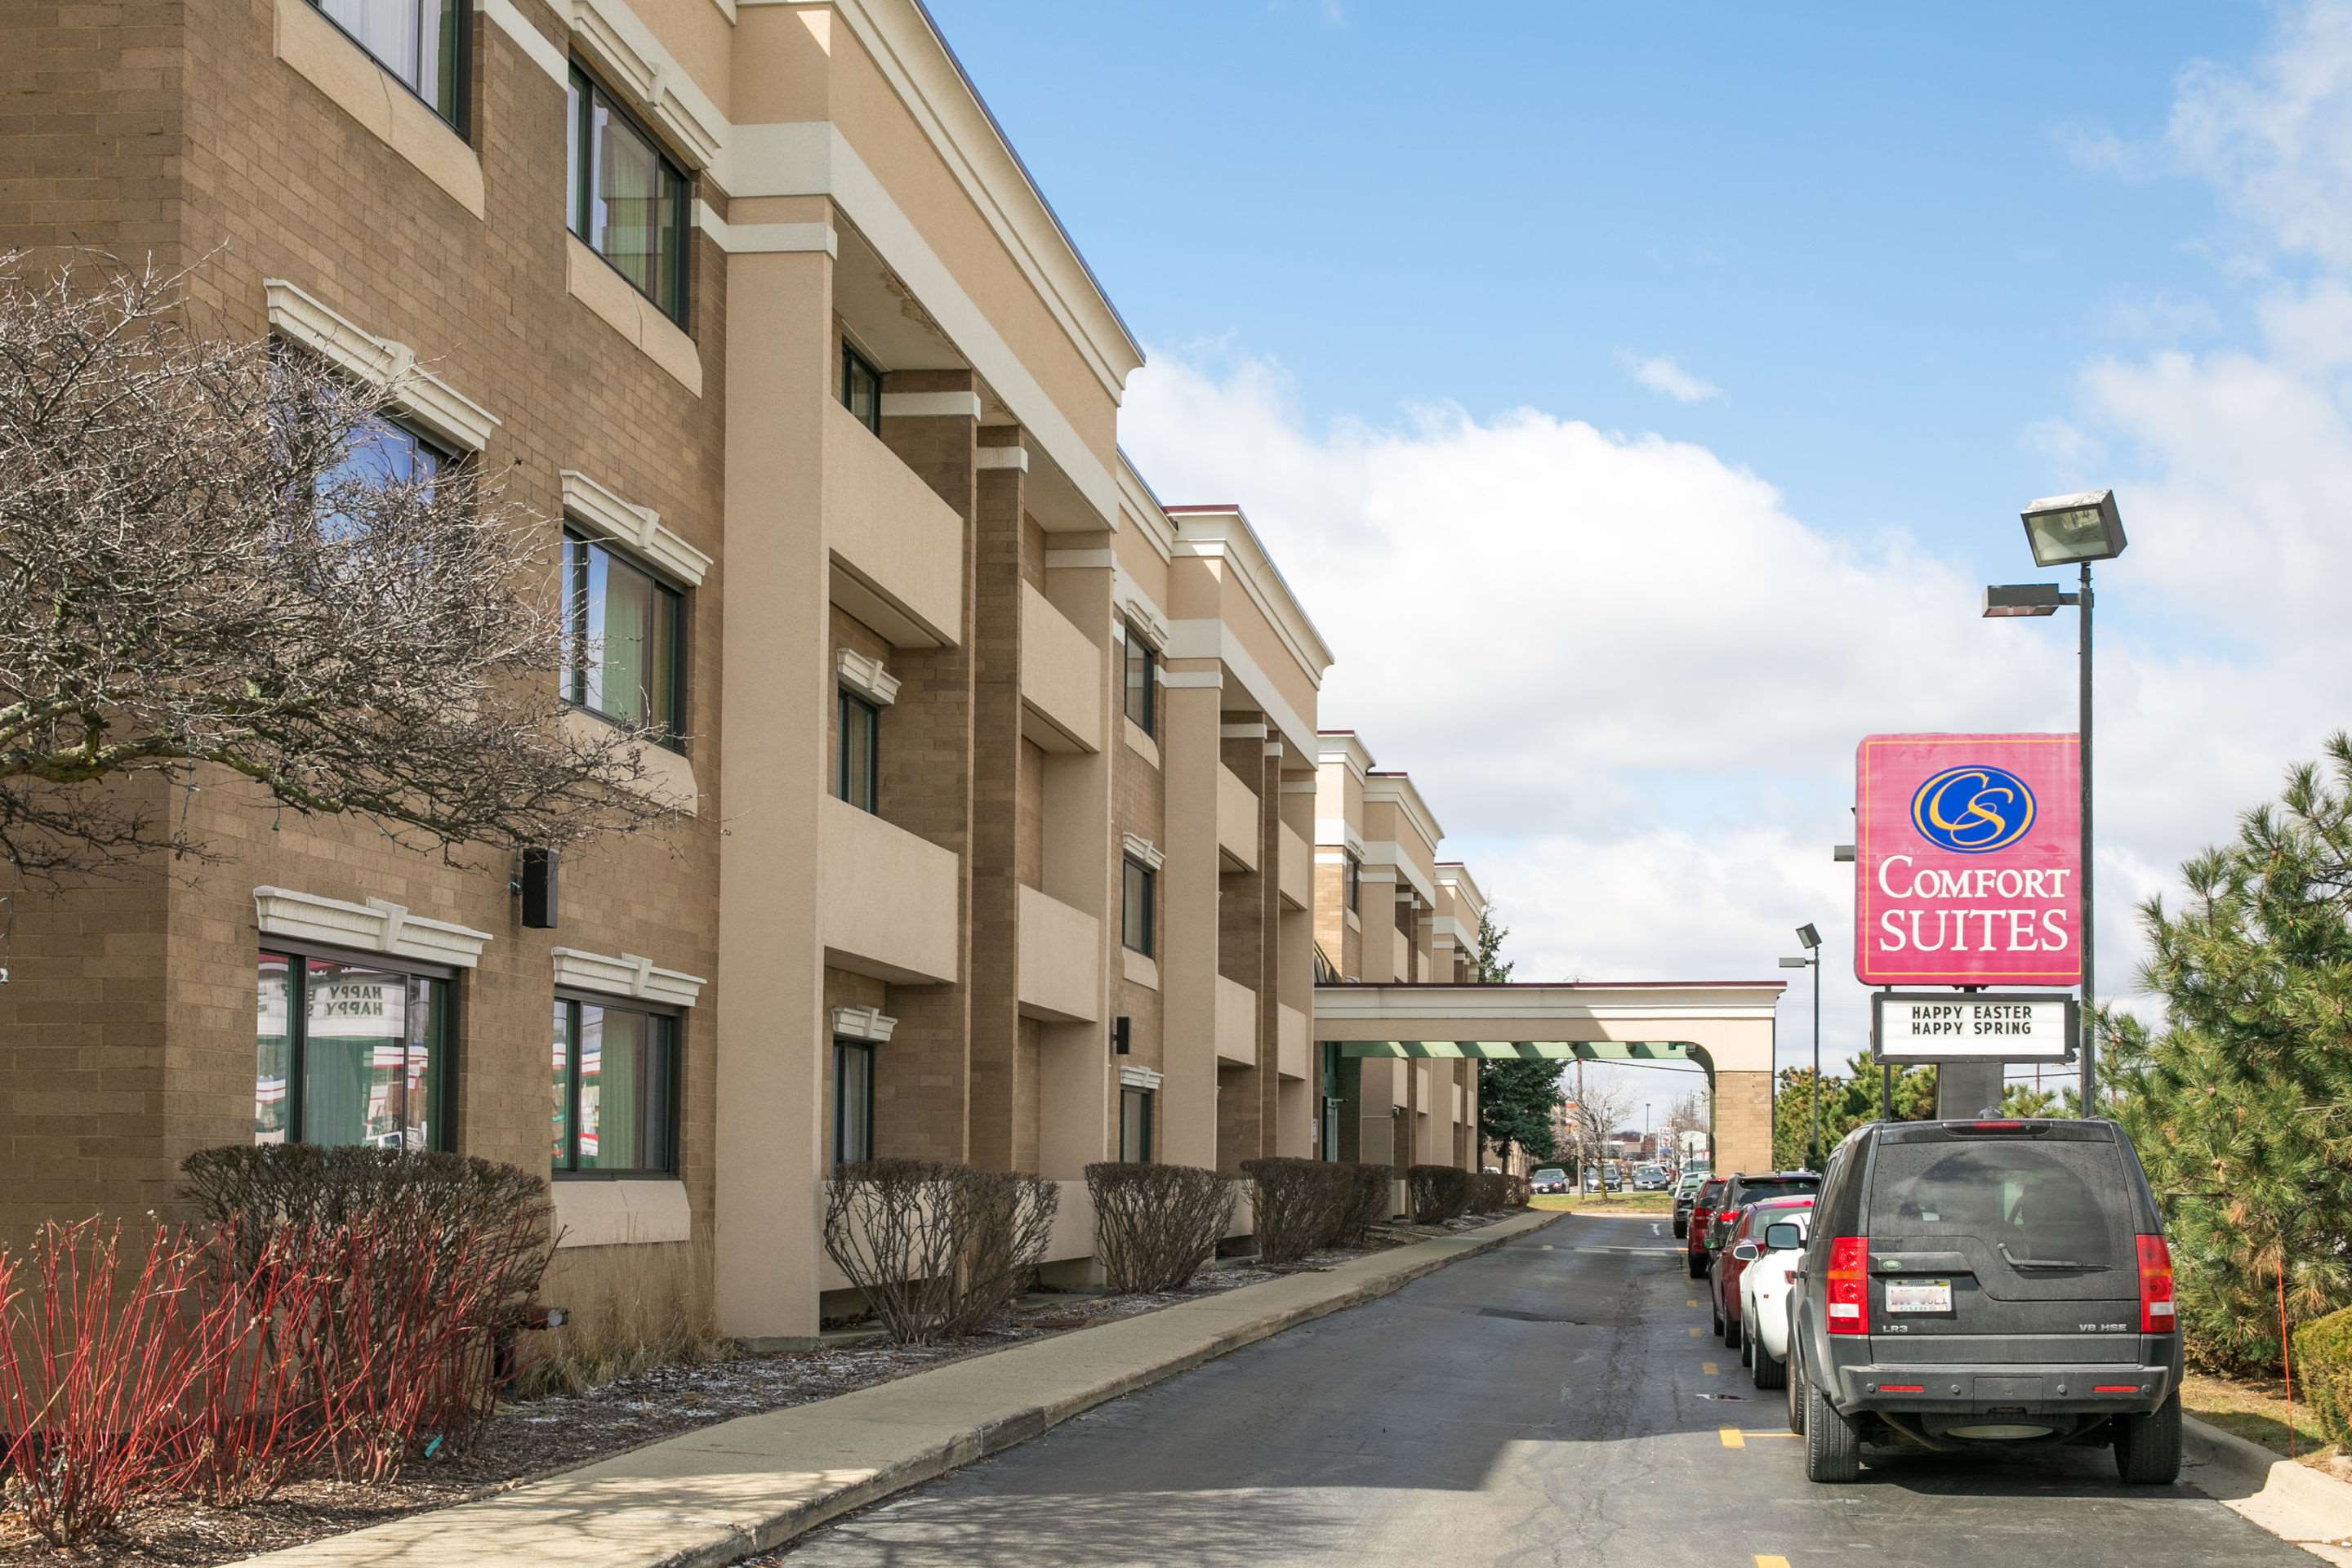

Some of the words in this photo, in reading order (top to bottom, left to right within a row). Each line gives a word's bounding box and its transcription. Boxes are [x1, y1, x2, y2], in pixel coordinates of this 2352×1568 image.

[1879, 908, 2069, 952] SUITES
[1912, 1005, 1962, 1019] HAPPY
[1974, 1005, 2032, 1019] EASTER
[1912, 1022, 1962, 1035] HAPPY
[1974, 1022, 2031, 1035] SPRING
[1882, 1325, 1908, 1333] LR3
[2078, 1323, 2096, 1332] V8
[2100, 1323, 2127, 1332] HSE
